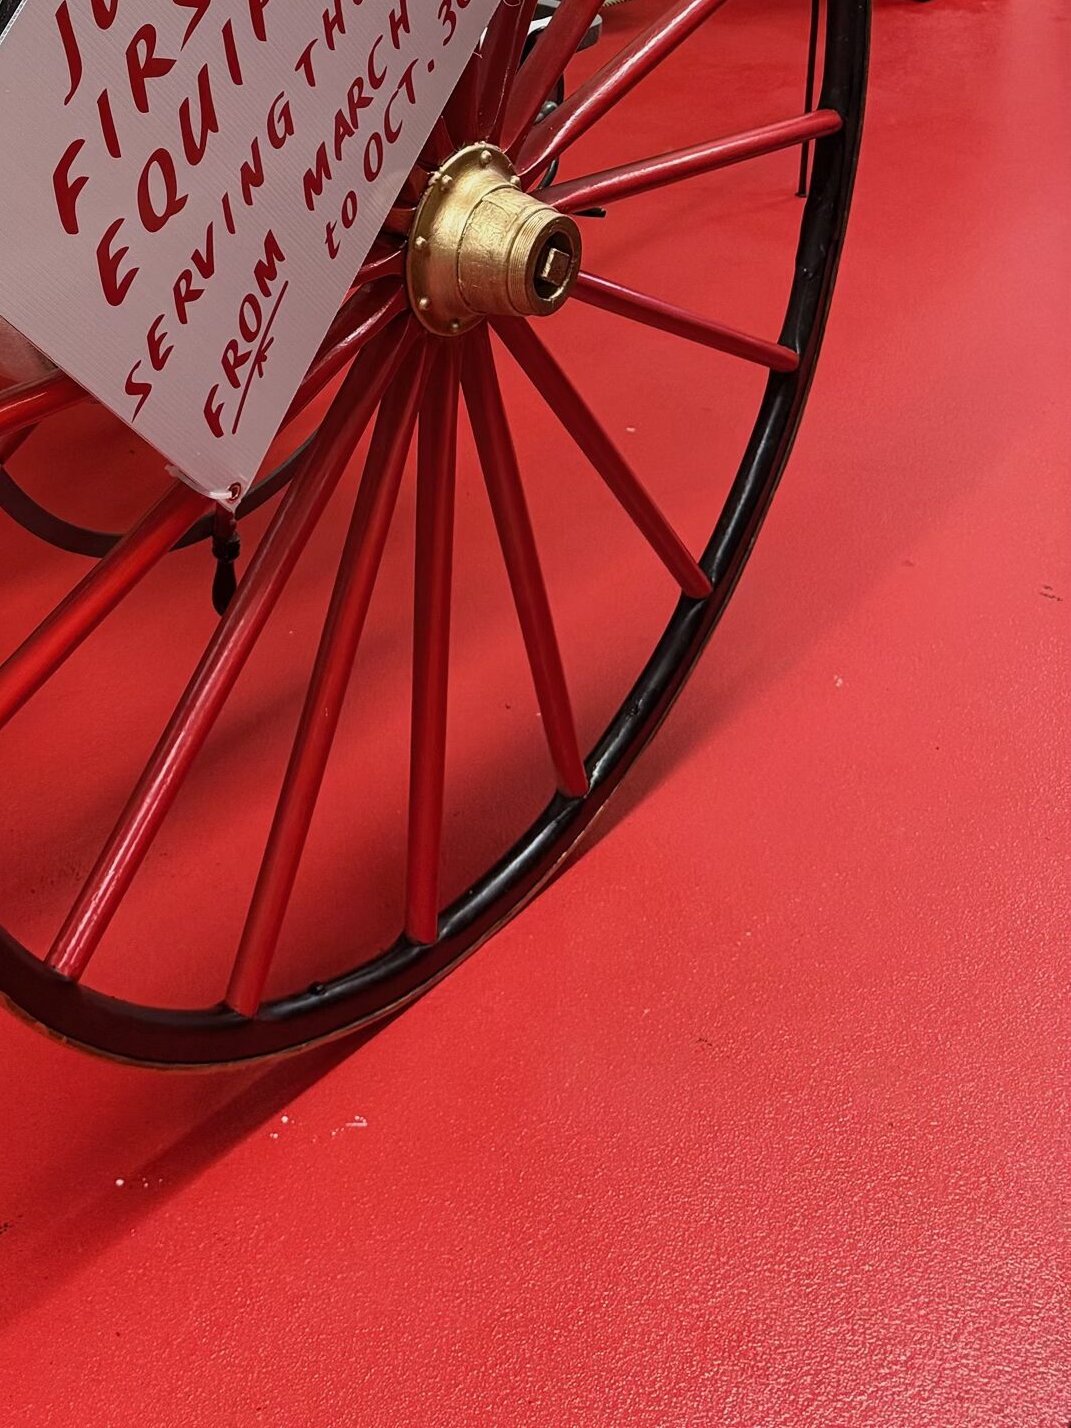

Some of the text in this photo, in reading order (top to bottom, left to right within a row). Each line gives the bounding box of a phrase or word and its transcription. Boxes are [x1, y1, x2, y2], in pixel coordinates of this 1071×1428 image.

[124, 90, 295, 423] SERVING
[325, 189, 358, 260] to
[363, 58, 436, 183] OCT.
[203, 228, 287, 439] FROM
